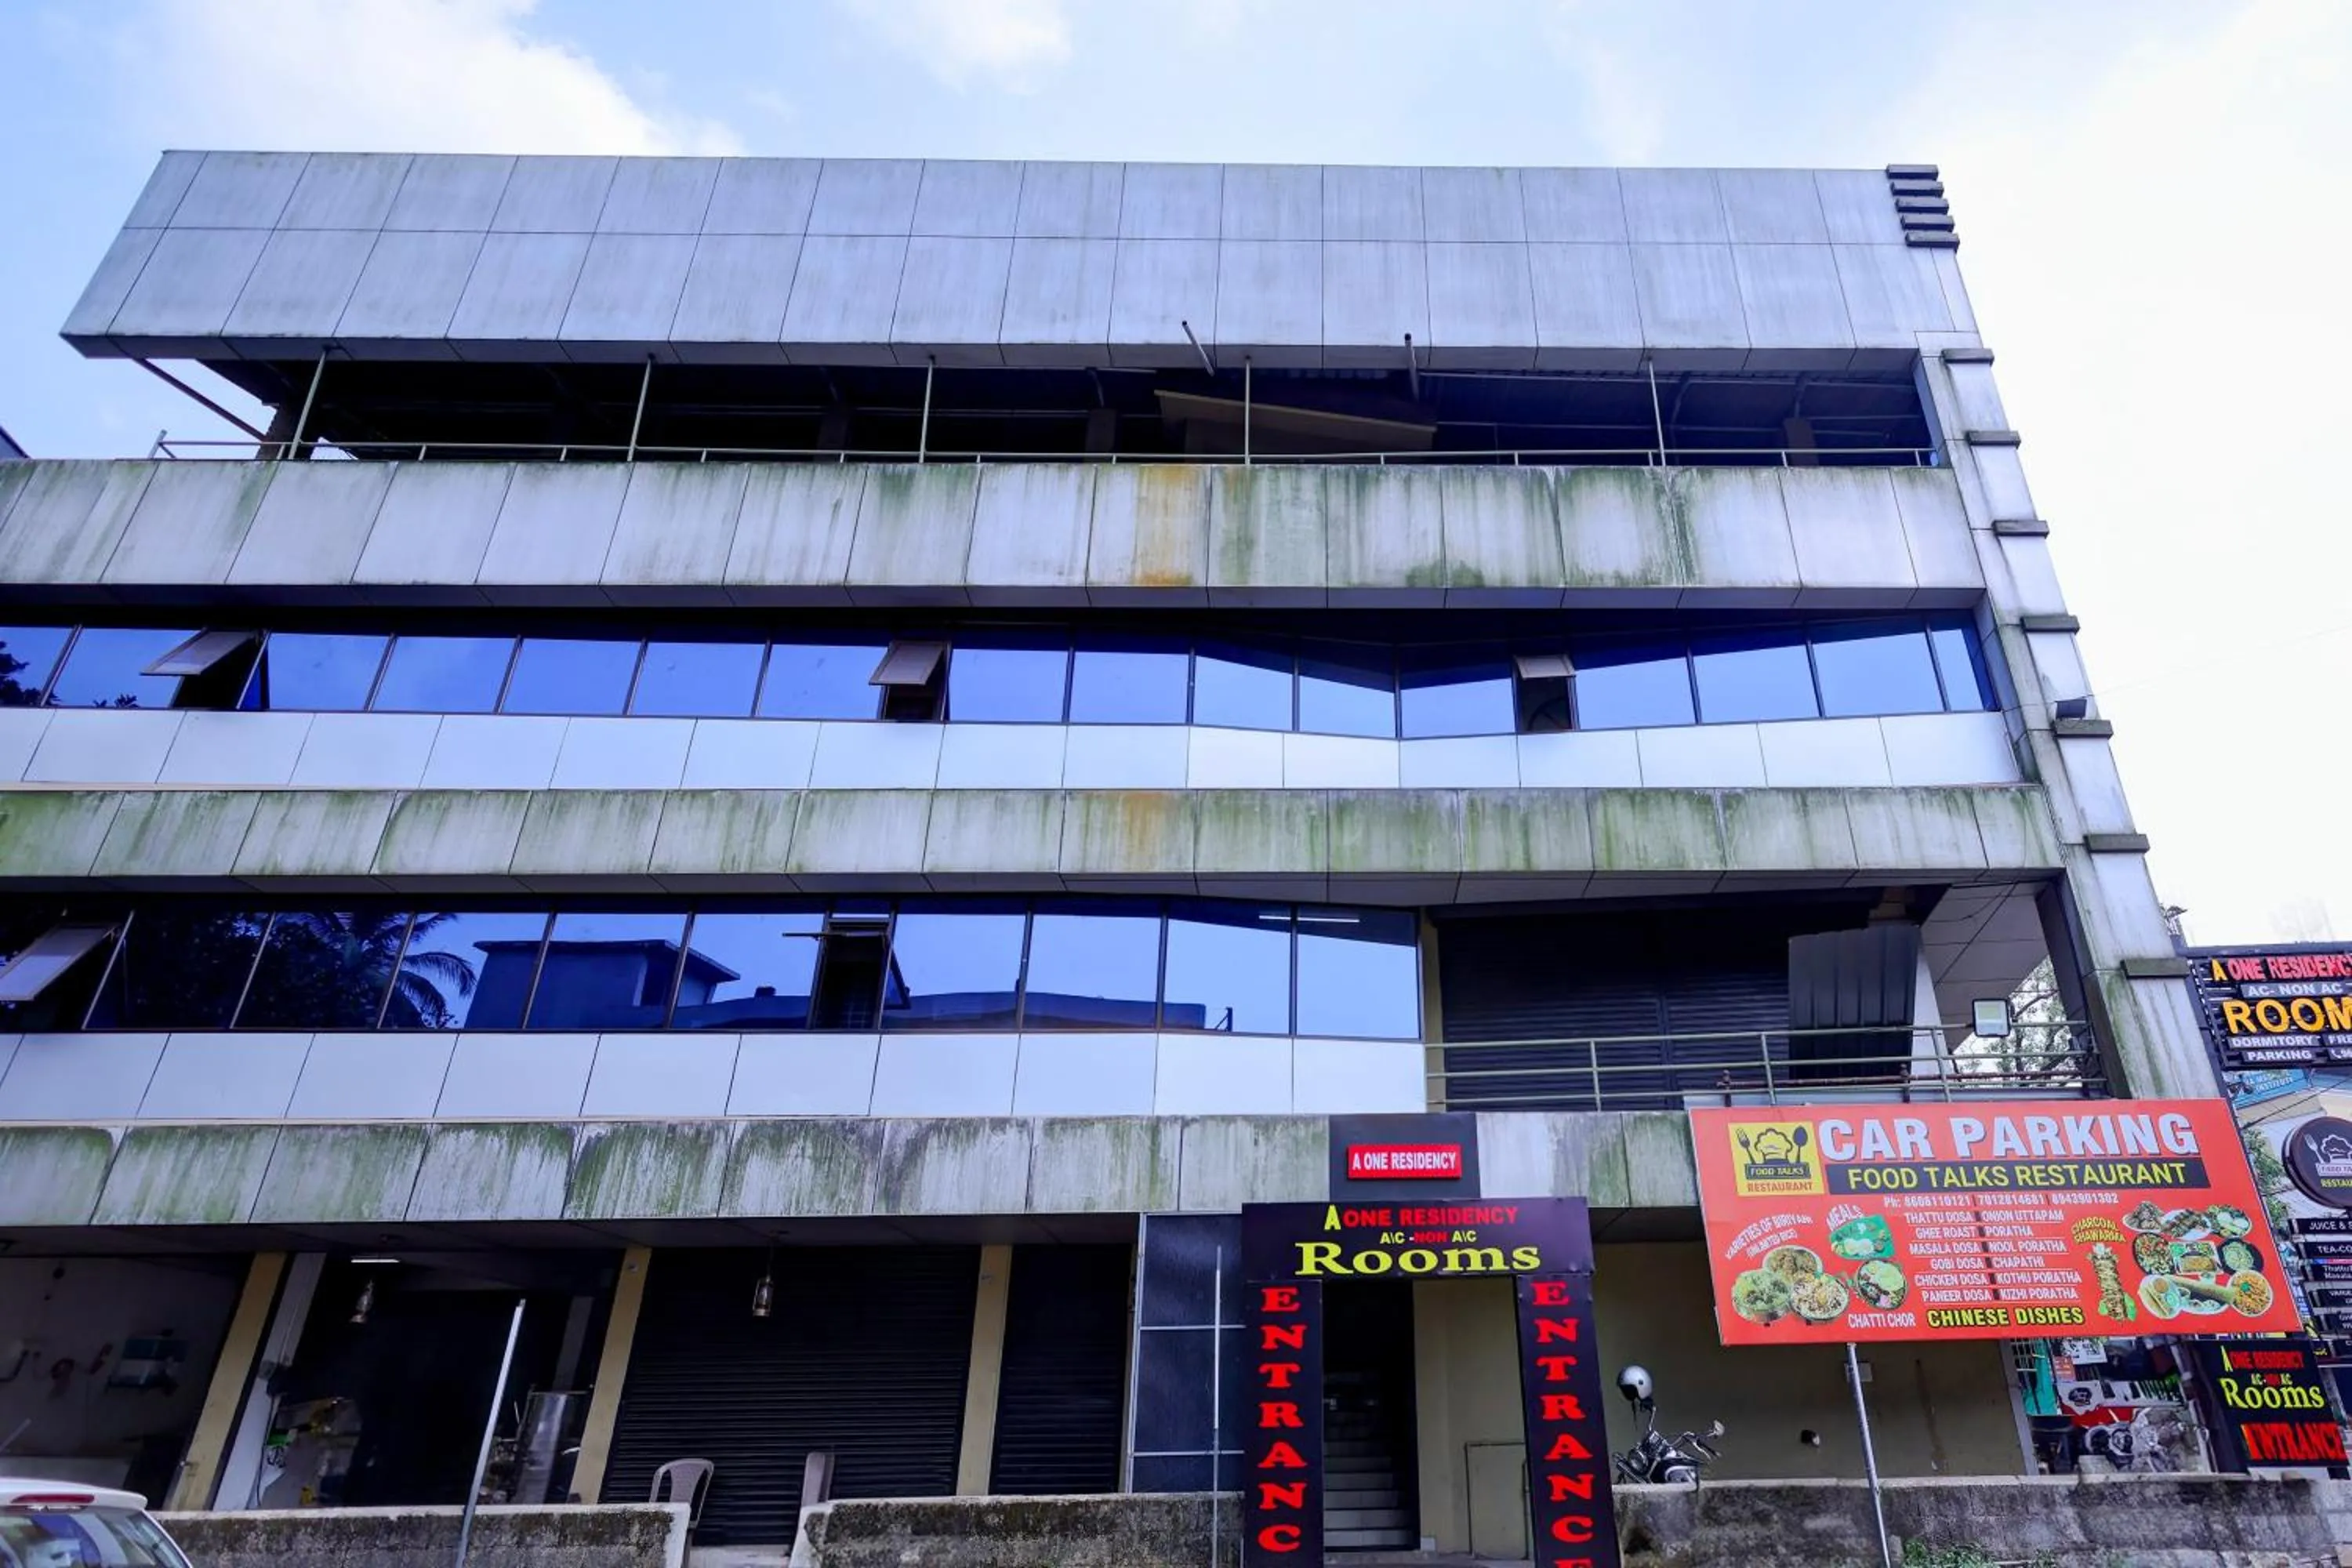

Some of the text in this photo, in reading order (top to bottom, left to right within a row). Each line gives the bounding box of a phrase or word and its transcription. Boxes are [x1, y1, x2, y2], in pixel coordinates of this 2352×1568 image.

[2212, 954, 2352, 981] A ONE RESIDENC
[2279, 984, 2315, 995] NON
[2321, 982, 2343, 993] AC
[2232, 1035, 2313, 1047] DORMITORY
[2247, 1050, 2312, 1061] PARKING
[1818, 1112, 2200, 1161] CAR PARKING
[1352, 1152, 1456, 1170] A ONE RESIDENCY
[1777, 1167, 1804, 1175] TALKS
[1848, 1162, 2187, 1190] FOOD TALKS RESTAURANT
[1747, 1181, 1813, 1192] RESTAURANT
[1324, 1204, 1519, 1230] A ONE RESIDENCY
[1826, 1203, 1864, 1232] MEALS
[1904, 1211, 1973, 1224] THATTU DOSA
[1981, 1210, 2064, 1222] ONION UTTAPAM
[1915, 1226, 1976, 1239] GHEE ROAST
[1985, 1225, 2034, 1237] PORATHA
[1909, 1242, 1982, 1255] MASALA DOSA
[1987, 1240, 2067, 1253] NOOL PORATHA
[1294, 1242, 1541, 1276] Rooms
[1931, 1257, 1984, 1270] GOBI DOSA
[1991, 1256, 2045, 1269] CHAPATHI
[1914, 1273, 1988, 1287] CHICKEN DOSA
[1996, 1272, 2082, 1285] KOTHU PORATHA
[1922, 1290, 1992, 1302] PANEER DOSA
[2000, 1287, 2078, 1301] KIZHI PORATHA
[1848, 1312, 1916, 1328] CHATTI CHOR
[1927, 1306, 2084, 1327] CHINESE DISHES
[2220, 1345, 2234, 1372] A
[2218, 1377, 2325, 1409] Rooms
